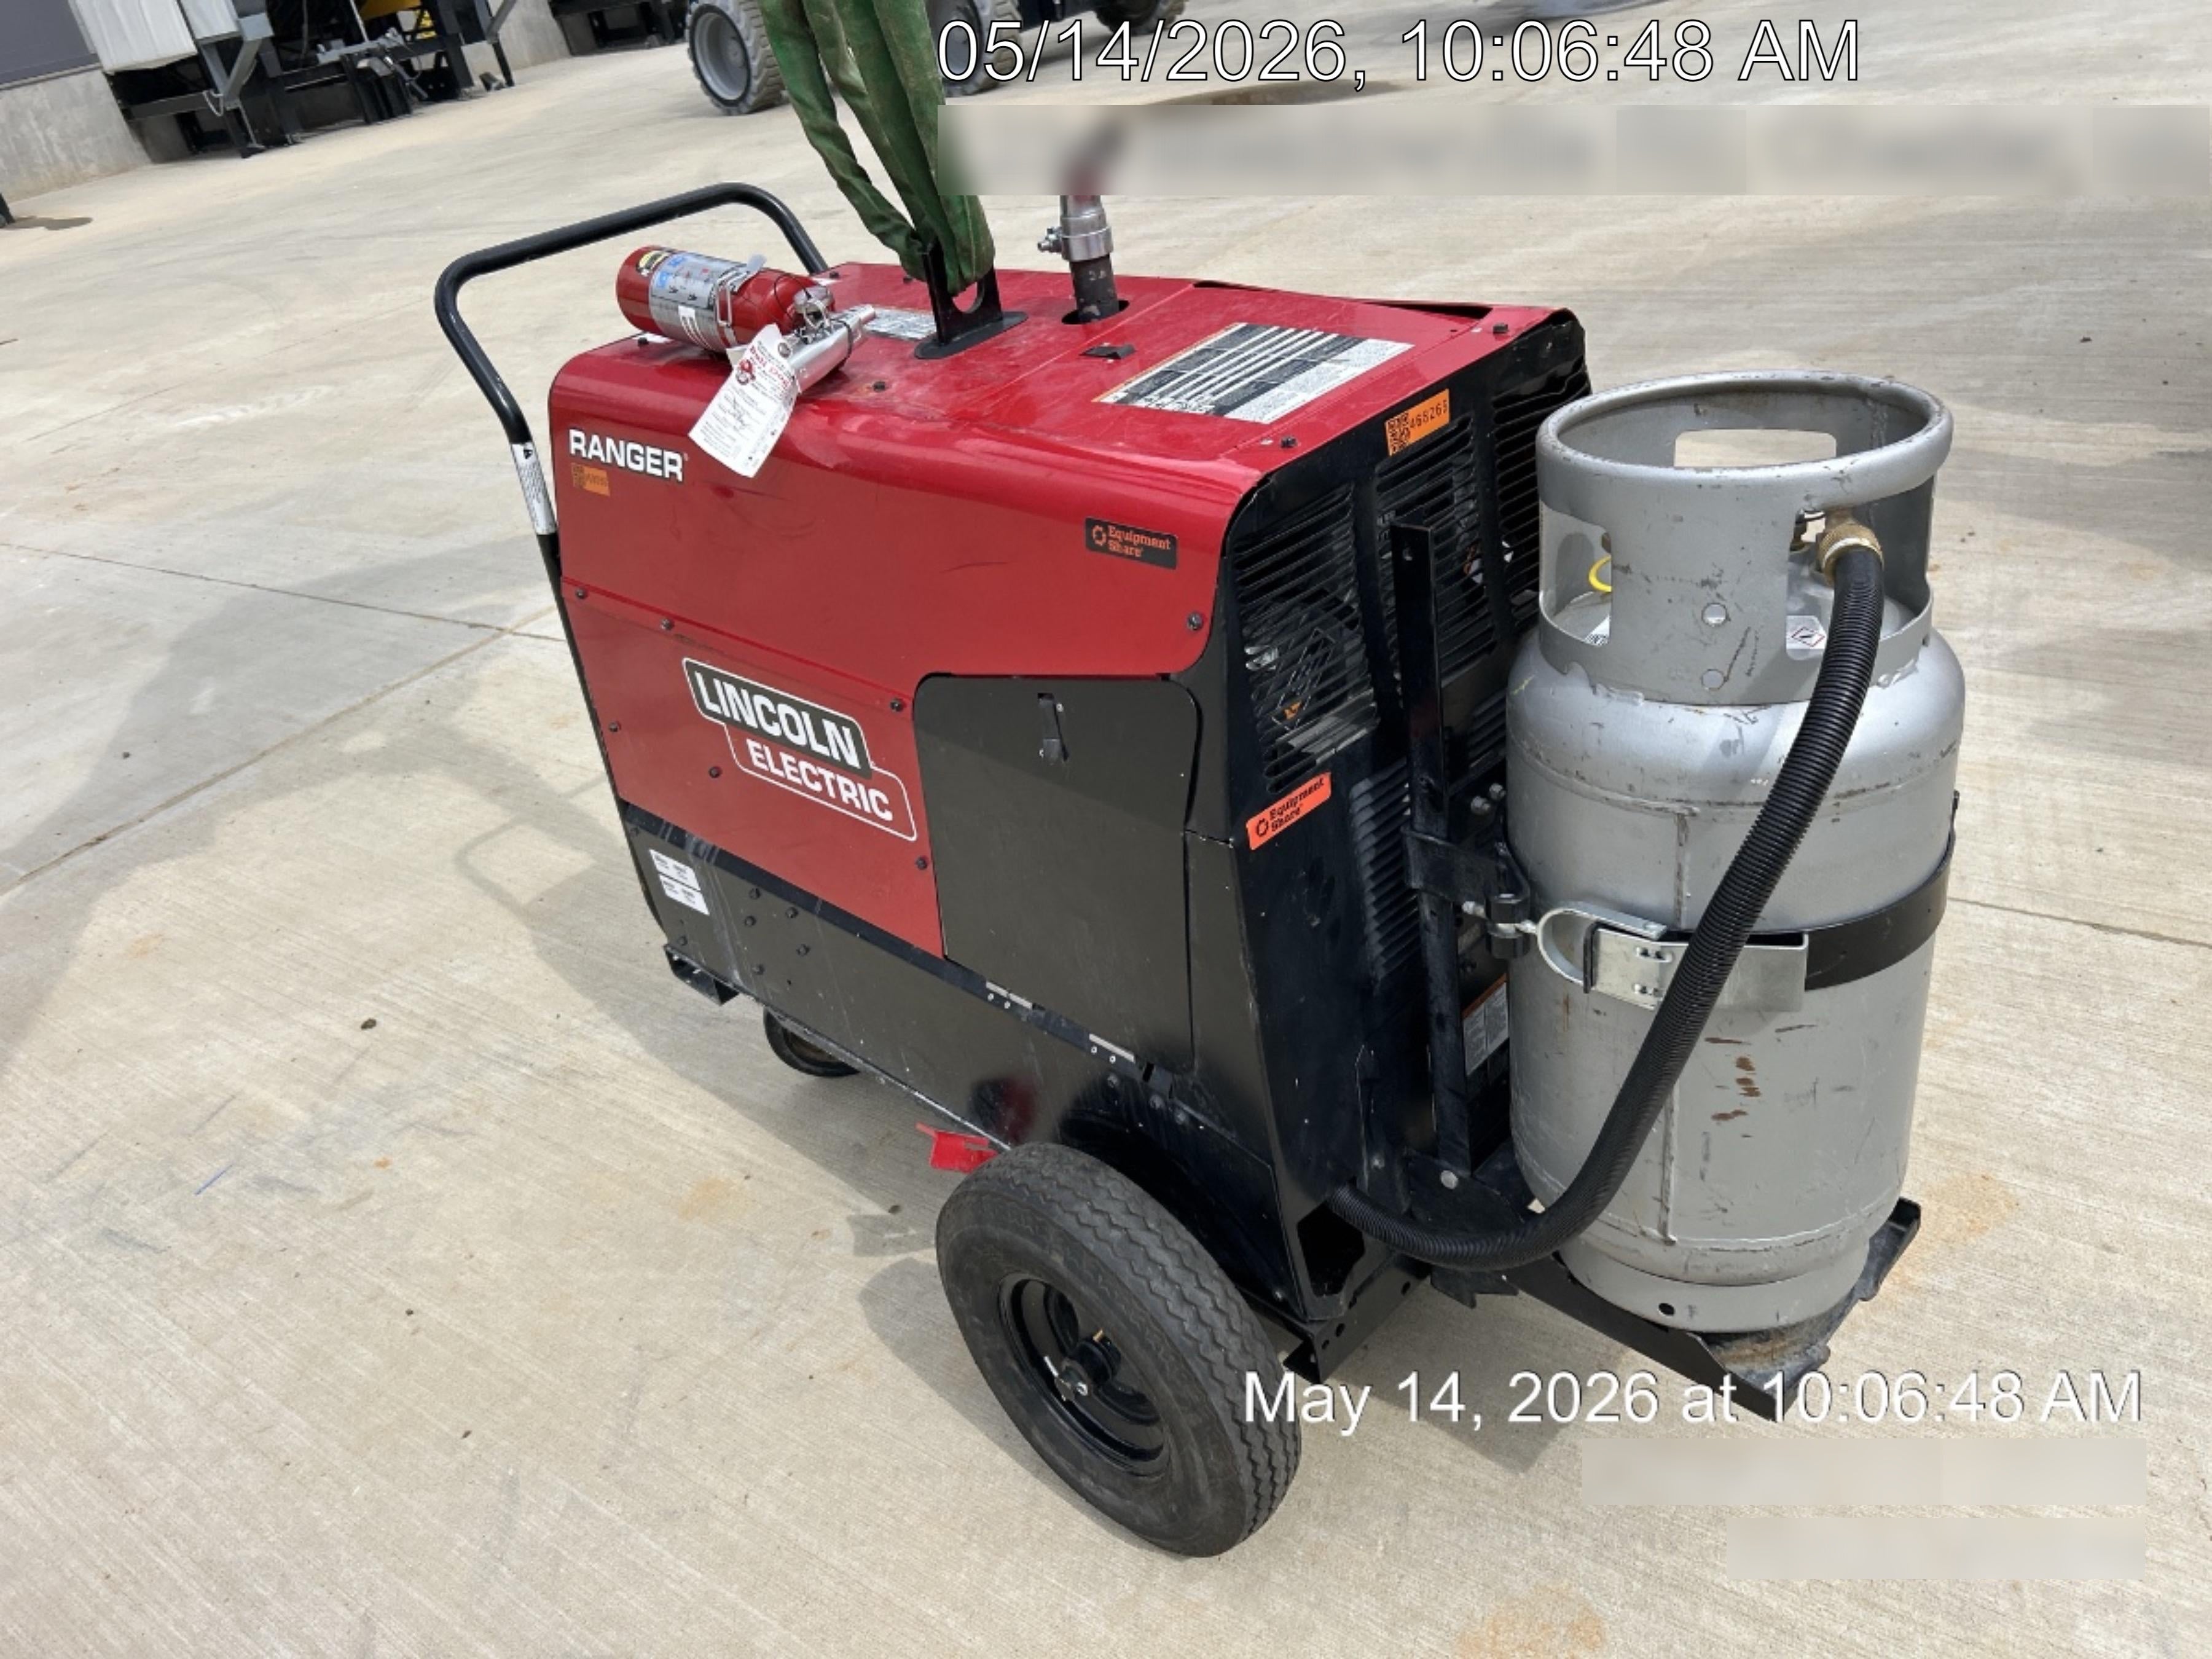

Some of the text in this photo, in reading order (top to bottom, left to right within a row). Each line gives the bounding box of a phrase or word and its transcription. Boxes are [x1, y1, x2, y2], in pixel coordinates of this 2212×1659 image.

[569, 428, 683, 482] RANGER
[1107, 525, 1172, 550] Equipment
[694, 670, 861, 770] LINCOLN
[745, 738, 893, 822] ELECTRIC
[1269, 777, 1325, 820] Equipment
